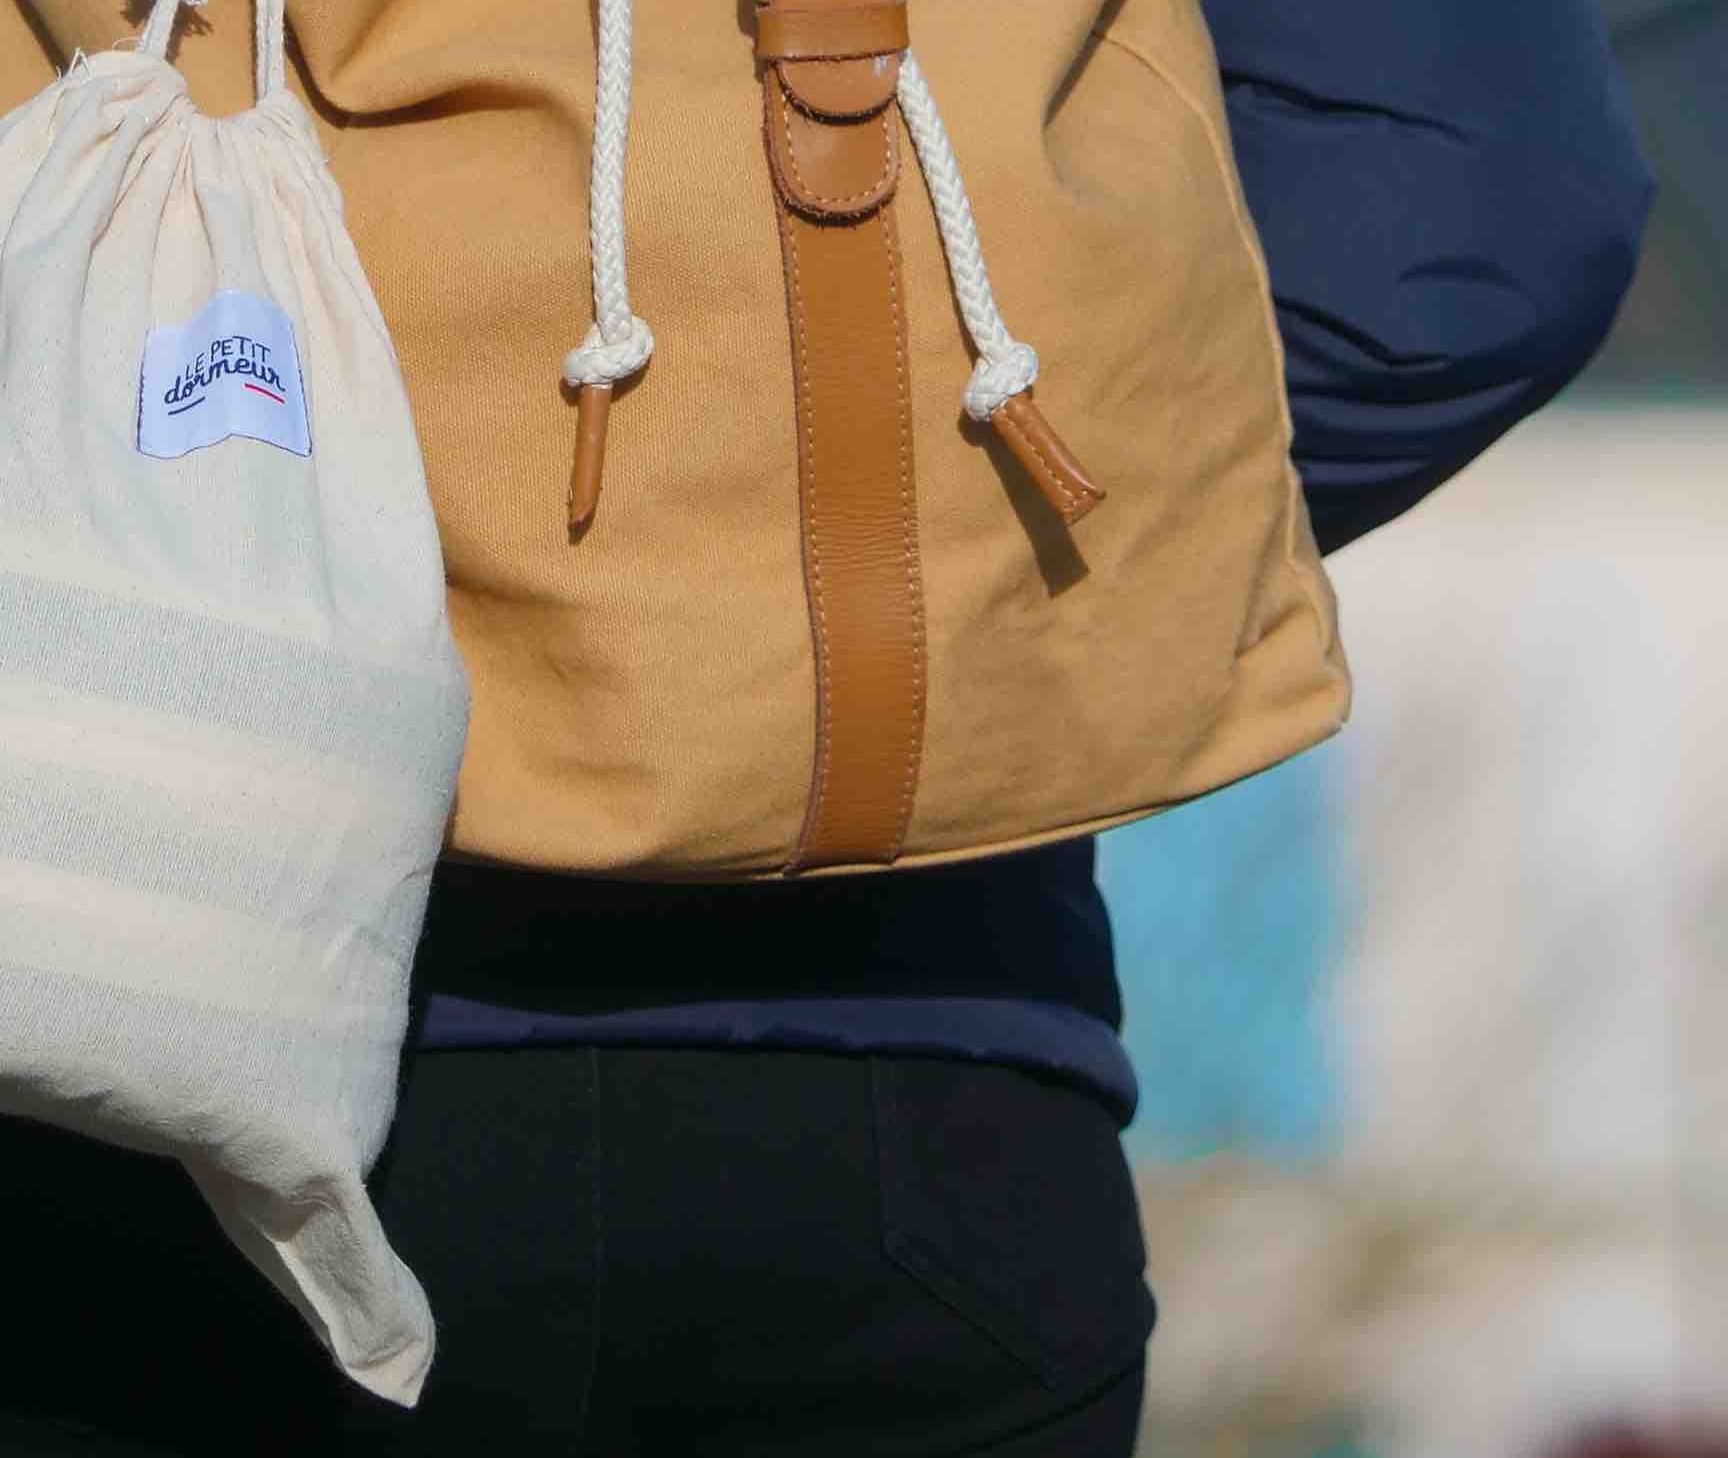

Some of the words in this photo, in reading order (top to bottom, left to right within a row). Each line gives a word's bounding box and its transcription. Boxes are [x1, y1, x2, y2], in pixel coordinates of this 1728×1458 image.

[164, 358, 286, 404] dormeur
[185, 352, 205, 381] LE
[211, 336, 271, 363] PETIT
